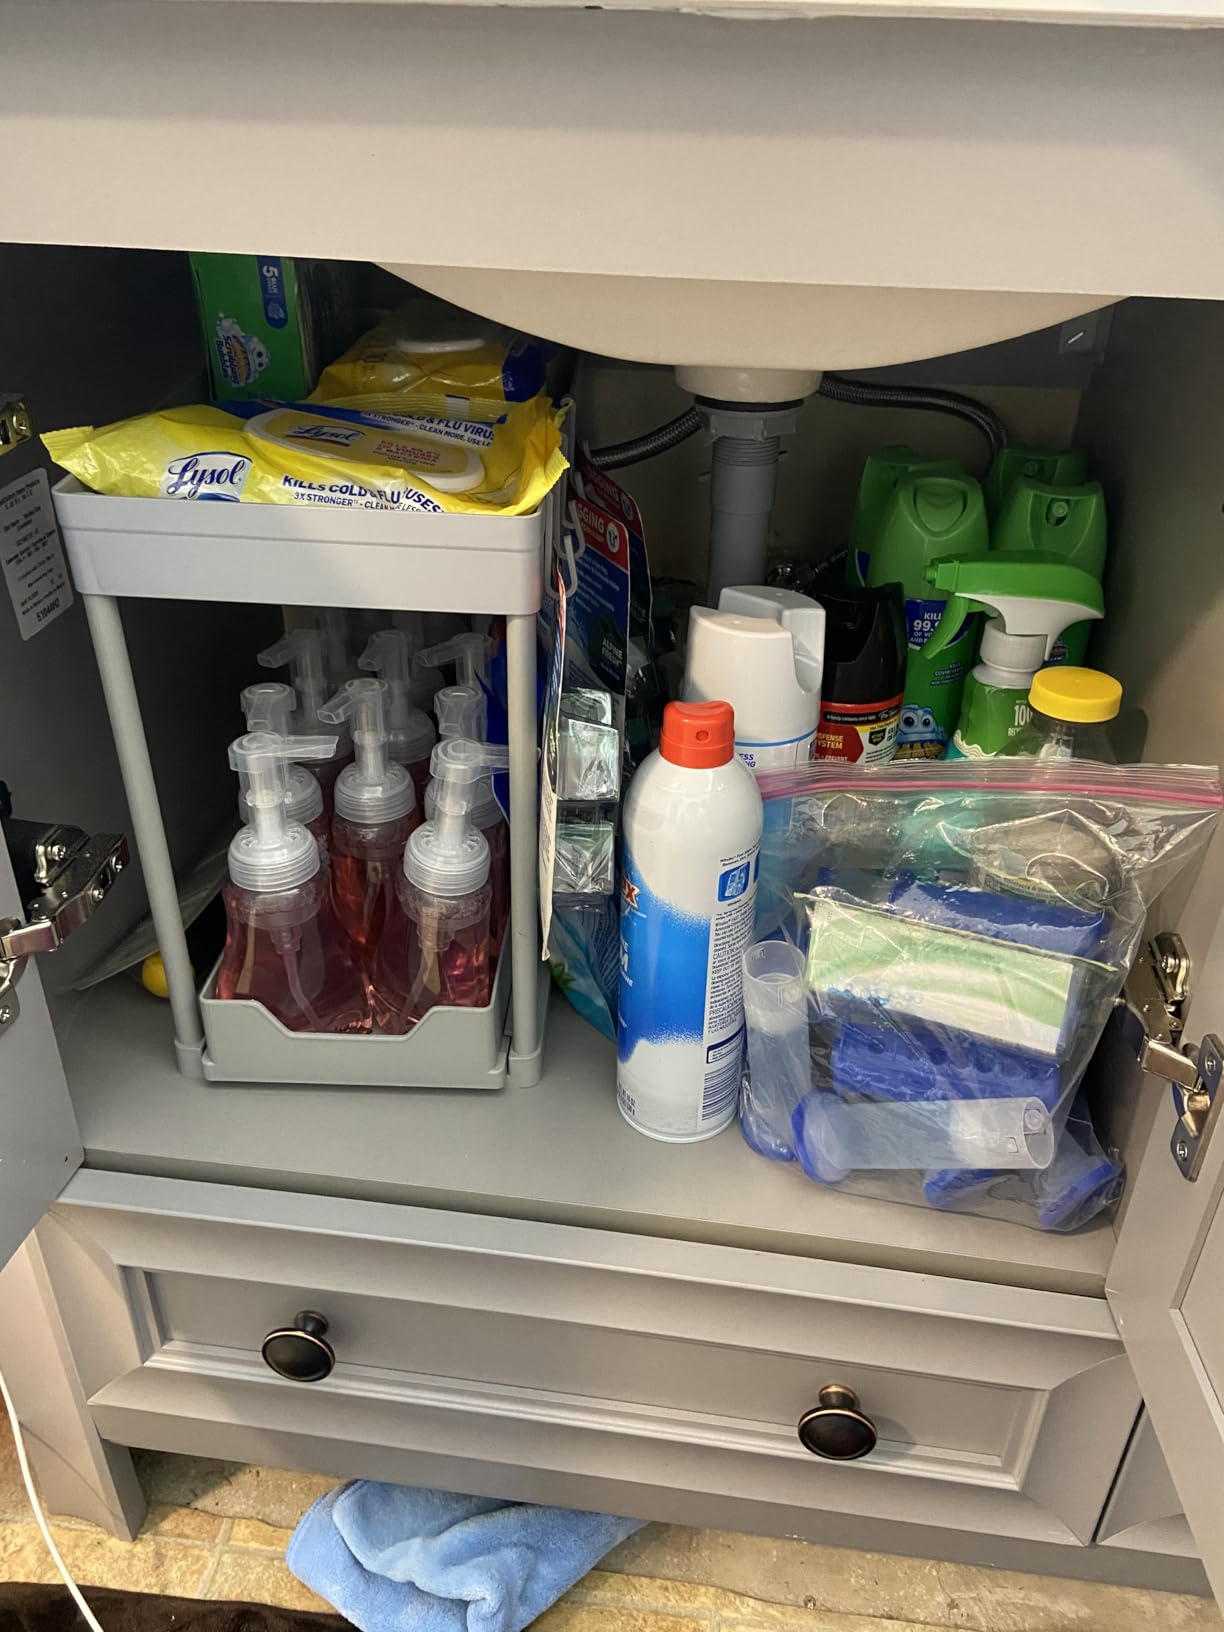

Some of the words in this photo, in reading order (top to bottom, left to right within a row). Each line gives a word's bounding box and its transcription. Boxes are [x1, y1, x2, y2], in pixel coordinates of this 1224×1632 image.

[262, 265, 279, 277] 5
[436, 419, 462, 430] FLU
[293, 425, 360, 441] Lysol
[419, 424, 443, 435] CLEAN
[467, 437, 481, 446] USE
[166, 457, 246, 497] Lysol
[282, 475, 326, 491] KILLS
[328, 484, 368, 497] COLD
[376, 488, 401, 504] FLU
[294, 491, 305, 501] 3X
